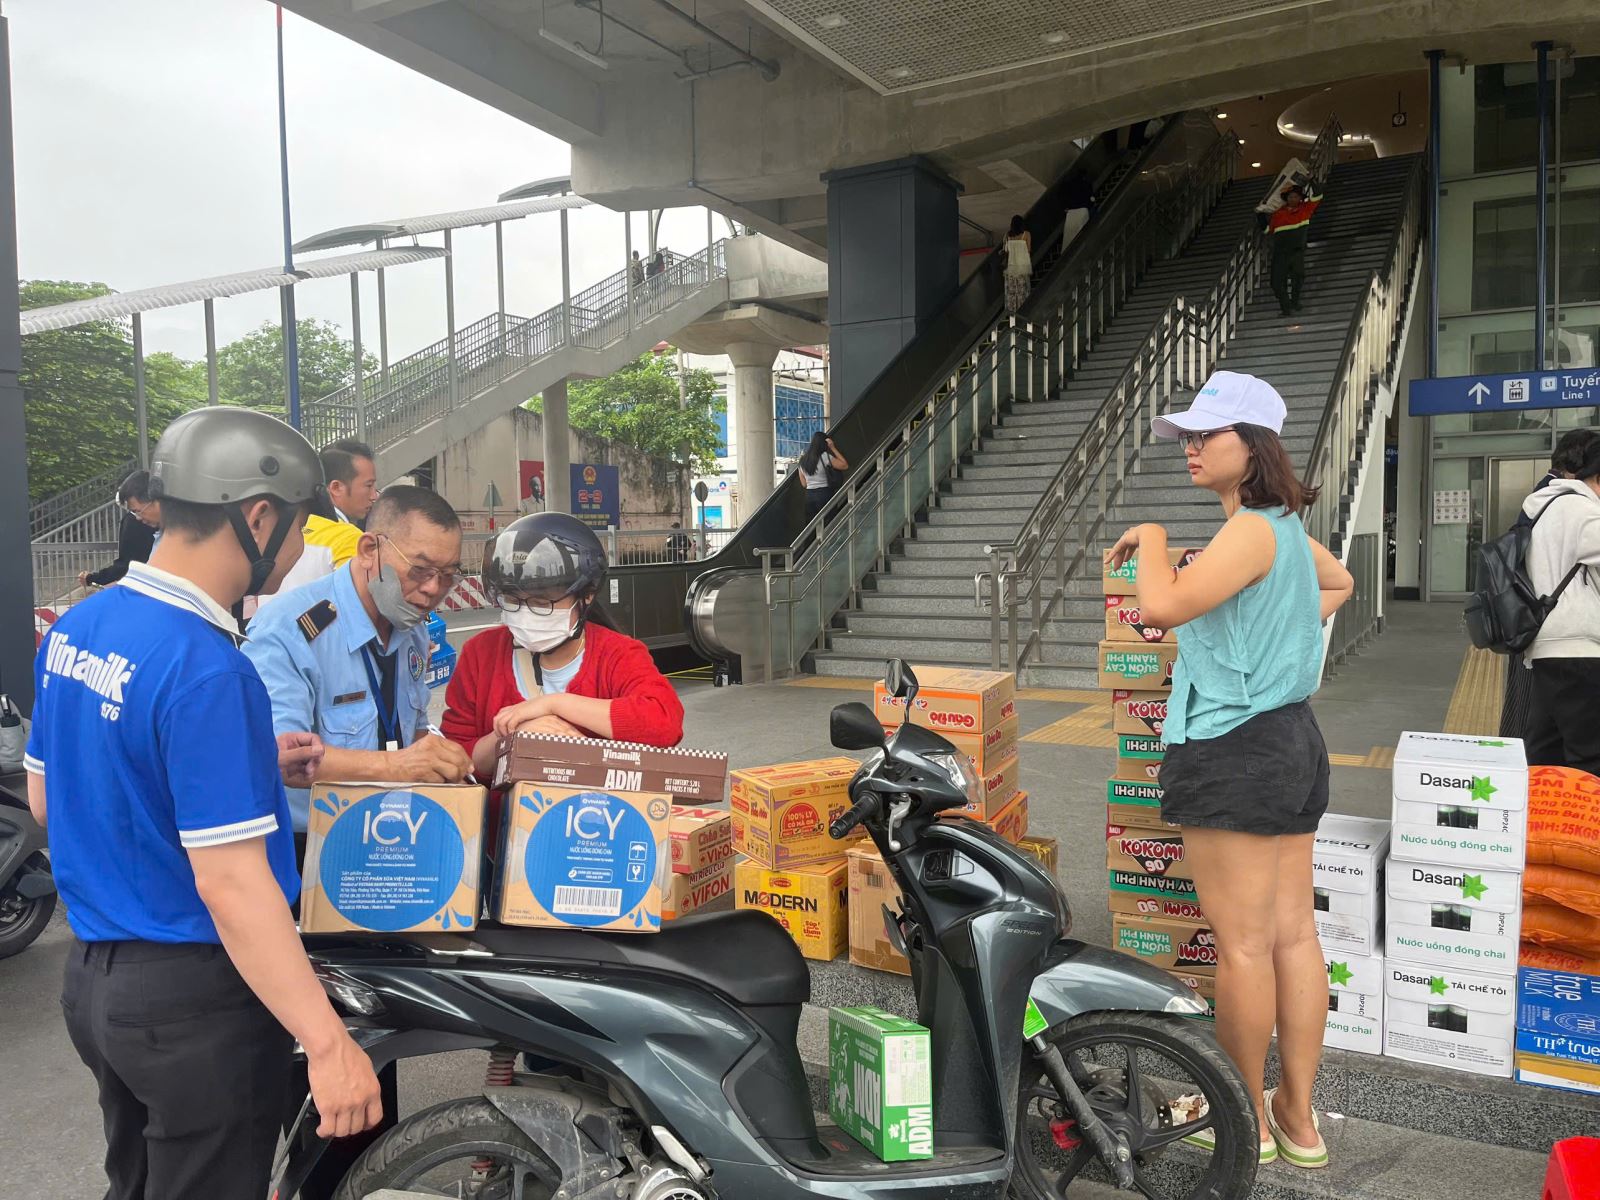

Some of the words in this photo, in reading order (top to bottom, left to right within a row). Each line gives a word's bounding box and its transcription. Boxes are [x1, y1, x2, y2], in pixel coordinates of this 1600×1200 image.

[1562, 391, 1584, 400] Line
[1587, 390, 1591, 399] 1
[1107, 653, 1125, 662] PHI
[45, 631, 132, 704] Vinamilk
[1105, 663, 1126, 672] CAY
[1125, 740, 1149, 752] PHI
[603, 749, 641, 761] Vinamilk
[548, 775, 570, 783] CHOCOLATE
[604, 769, 643, 792] ADM
[1420, 773, 1476, 790] Dasani
[1113, 784, 1136, 797] PHI
[363, 810, 428, 845] ICY
[565, 805, 626, 841] ICY
[576, 839, 607, 847] PREMIUM
[1119, 839, 1185, 861] KOKOMI
[1315, 838, 1370, 849] Dasa
[1459, 840, 1487, 852] đóng
[1489, 843, 1513, 854] chai
[1144, 860, 1165, 872] 90
[1115, 872, 1137, 885] PHI
[1139, 874, 1176, 893] HÀNH
[1412, 868, 1466, 888] Dasani
[692, 873, 730, 908] VIFON
[744, 889, 818, 913] MODERN
[1137, 899, 1159, 913] 90
[1120, 928, 1139, 939] PHI
[1119, 938, 1140, 949] CAY
[1454, 944, 1481, 958] đóng
[1484, 948, 1506, 960] chai
[1393, 970, 1434, 986] Dasani
[1468, 982, 1489, 994] CHẾ
[1490, 985, 1507, 996] TÔI
[1524, 970, 1554, 998] MILK
[1553, 974, 1588, 1002] true
[1352, 1025, 1372, 1035] chai
[1534, 1036, 1557, 1050] TH
[1568, 1040, 1600, 1057] true
[907, 1107, 932, 1155] ADM
